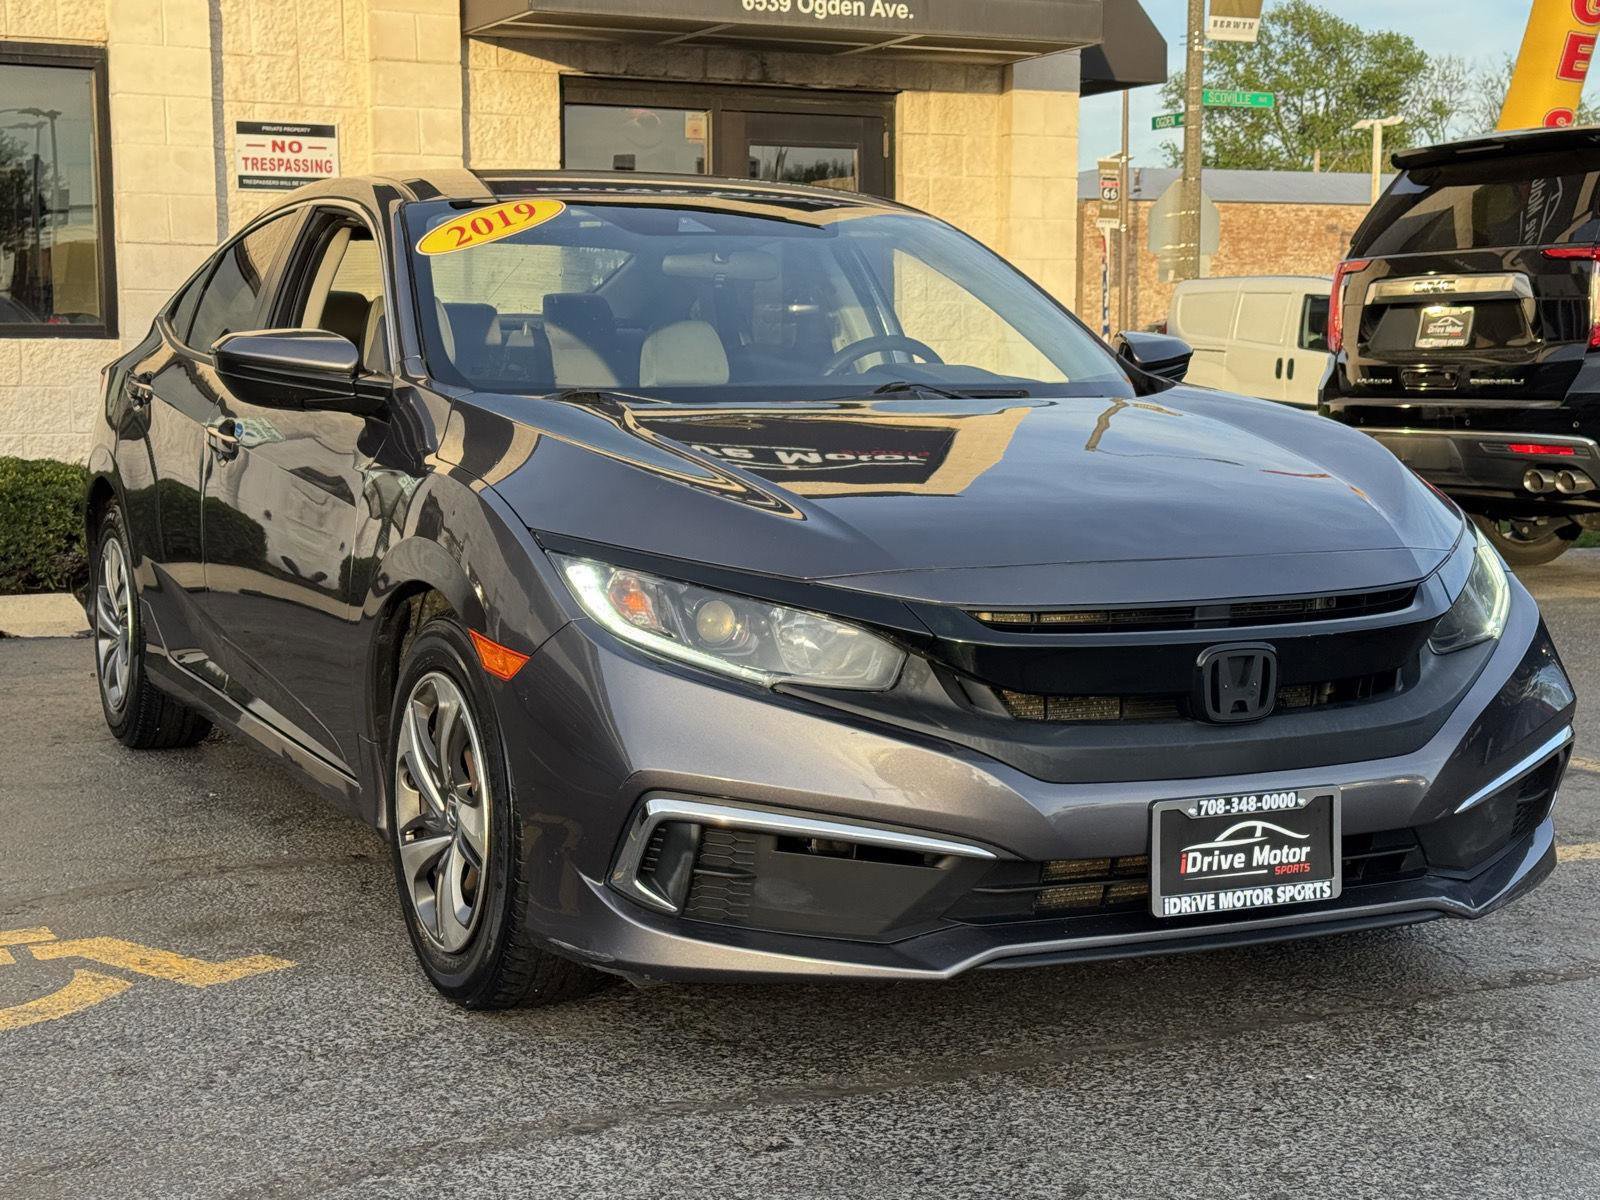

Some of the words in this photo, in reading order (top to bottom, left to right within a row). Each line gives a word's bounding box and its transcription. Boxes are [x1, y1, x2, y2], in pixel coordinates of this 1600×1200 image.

[742, 0, 791, 12] 6539
[797, 0, 865, 20] Ogden
[870, 0, 914, 19] Ave.
[1213, 19, 1254, 30] BERWYN
[1208, 91, 1252, 105] SCOVILLE
[262, 125, 282, 133] PRIVATE
[284, 126, 311, 134] PROPERTY
[271, 140, 303, 153] NO
[242, 157, 333, 174] TRESPASSING
[1103, 187, 1118, 200] 66
[446, 202, 536, 247] 2019
[1200, 792, 1296, 816] 708-348-0000
[1179, 850, 1246, 875] iDrive
[1252, 844, 1311, 867] Motor
[1274, 863, 1311, 875] SPORTS
[1218, 887, 1274, 909] MOTOR
[1276, 881, 1332, 903] SPORTS
